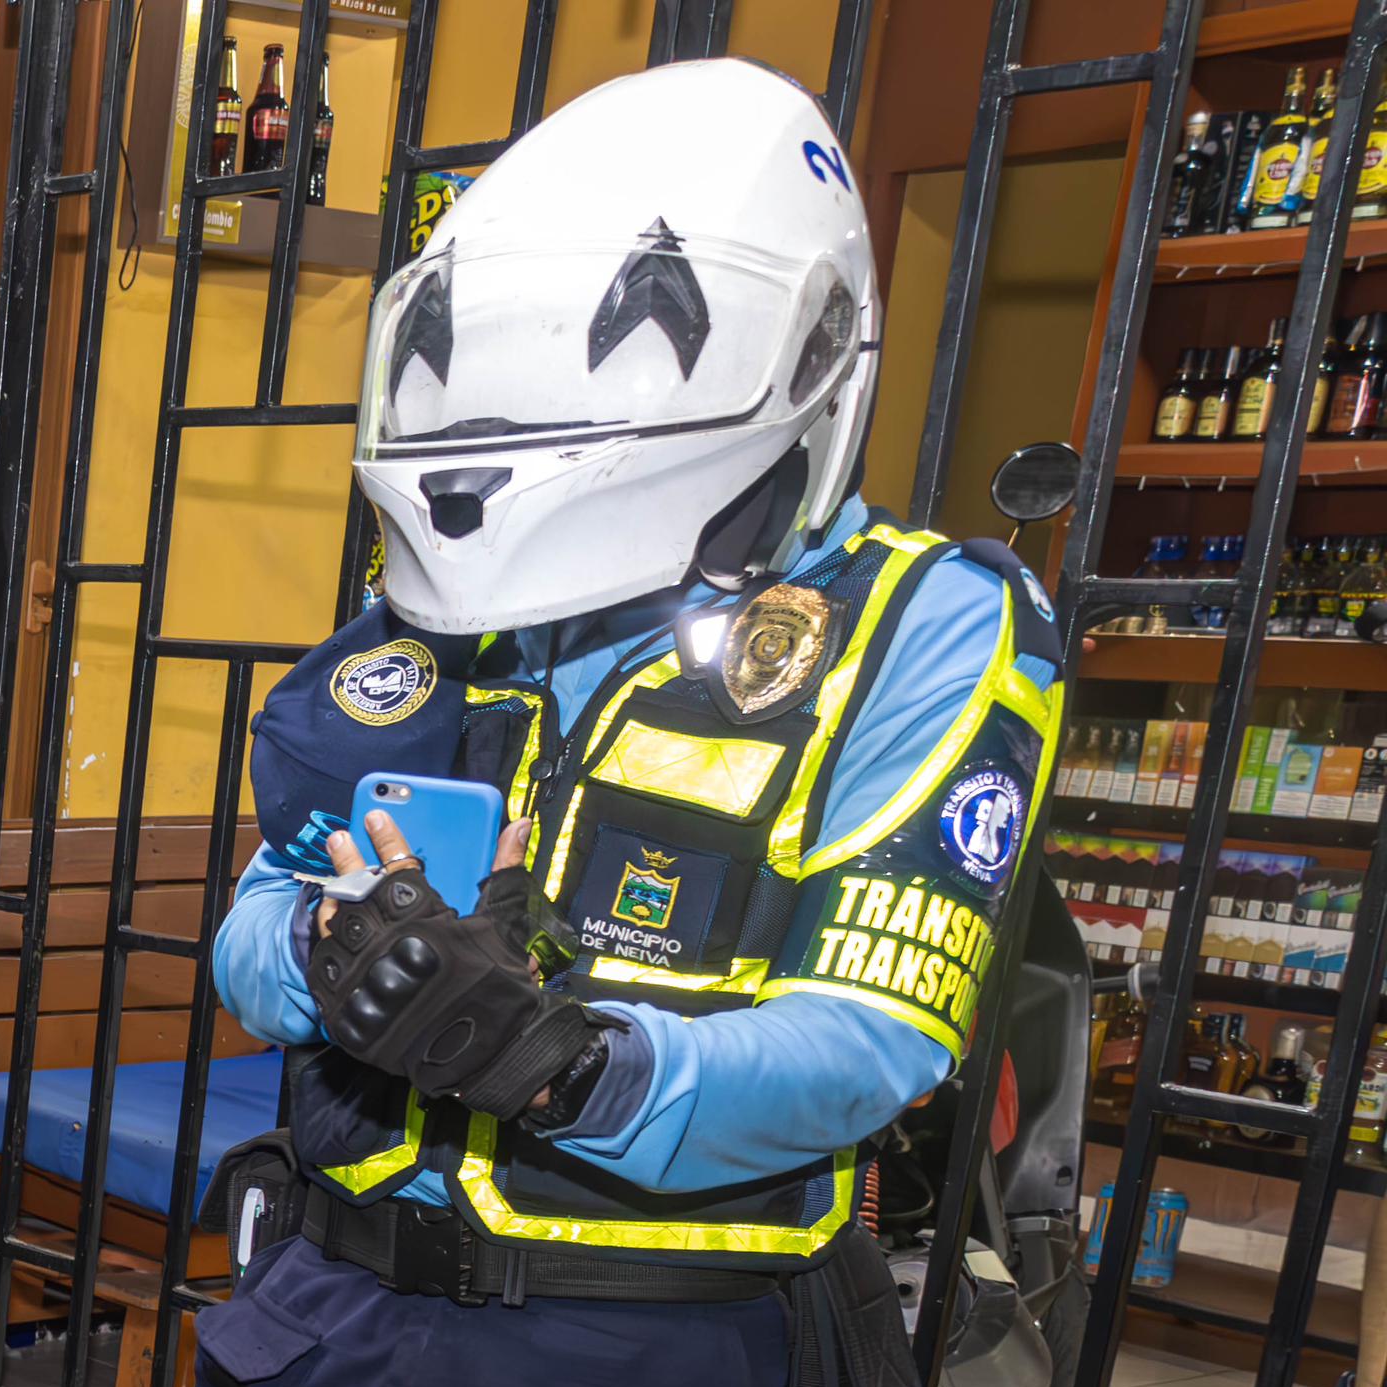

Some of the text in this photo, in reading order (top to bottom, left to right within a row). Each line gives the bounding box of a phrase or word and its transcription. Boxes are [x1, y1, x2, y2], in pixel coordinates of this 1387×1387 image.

[581, 933, 671, 968] DE NEIVA
[582, 916, 682, 954] MUNICIPIO
[833, 876, 995, 984] TRÁNSITO
[814, 928, 978, 1034] TRANSPO
